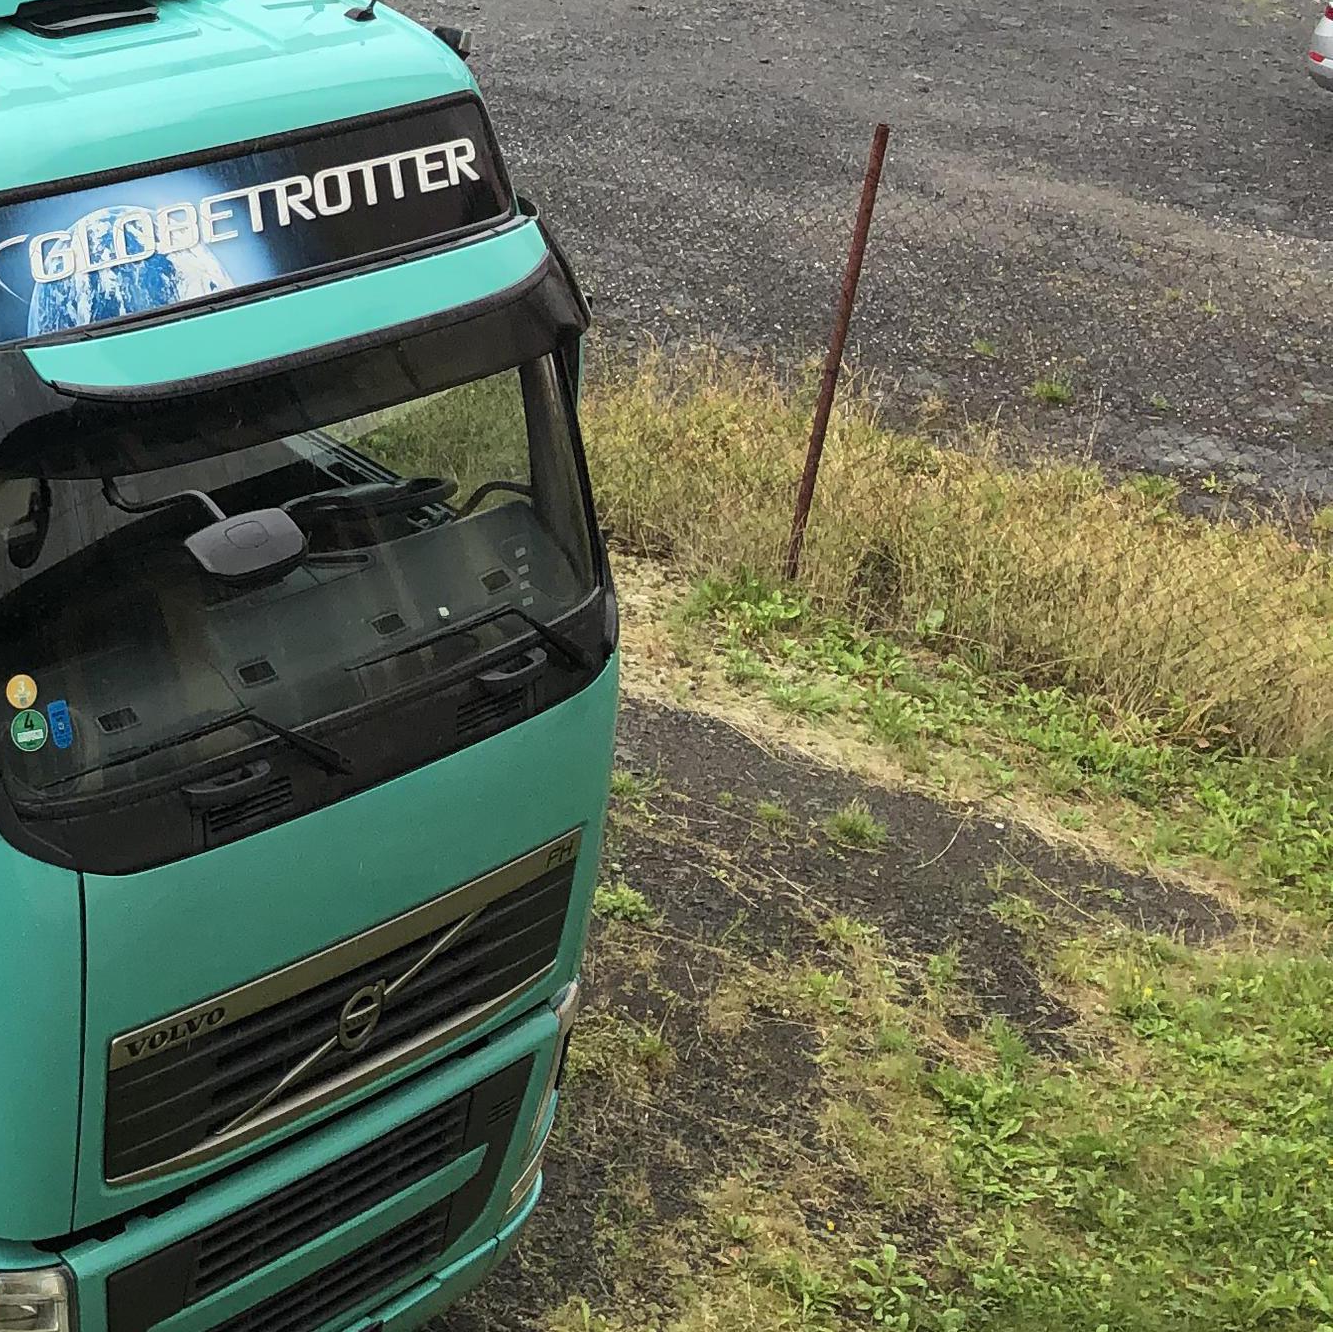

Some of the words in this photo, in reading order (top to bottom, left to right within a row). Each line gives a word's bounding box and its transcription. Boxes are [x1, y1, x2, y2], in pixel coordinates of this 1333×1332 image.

[29, 138, 481, 285] GLOBETROTTER
[24, 712, 35, 730] 4
[546, 838, 574, 868] FH
[124, 1007, 227, 1058] VOLVO
